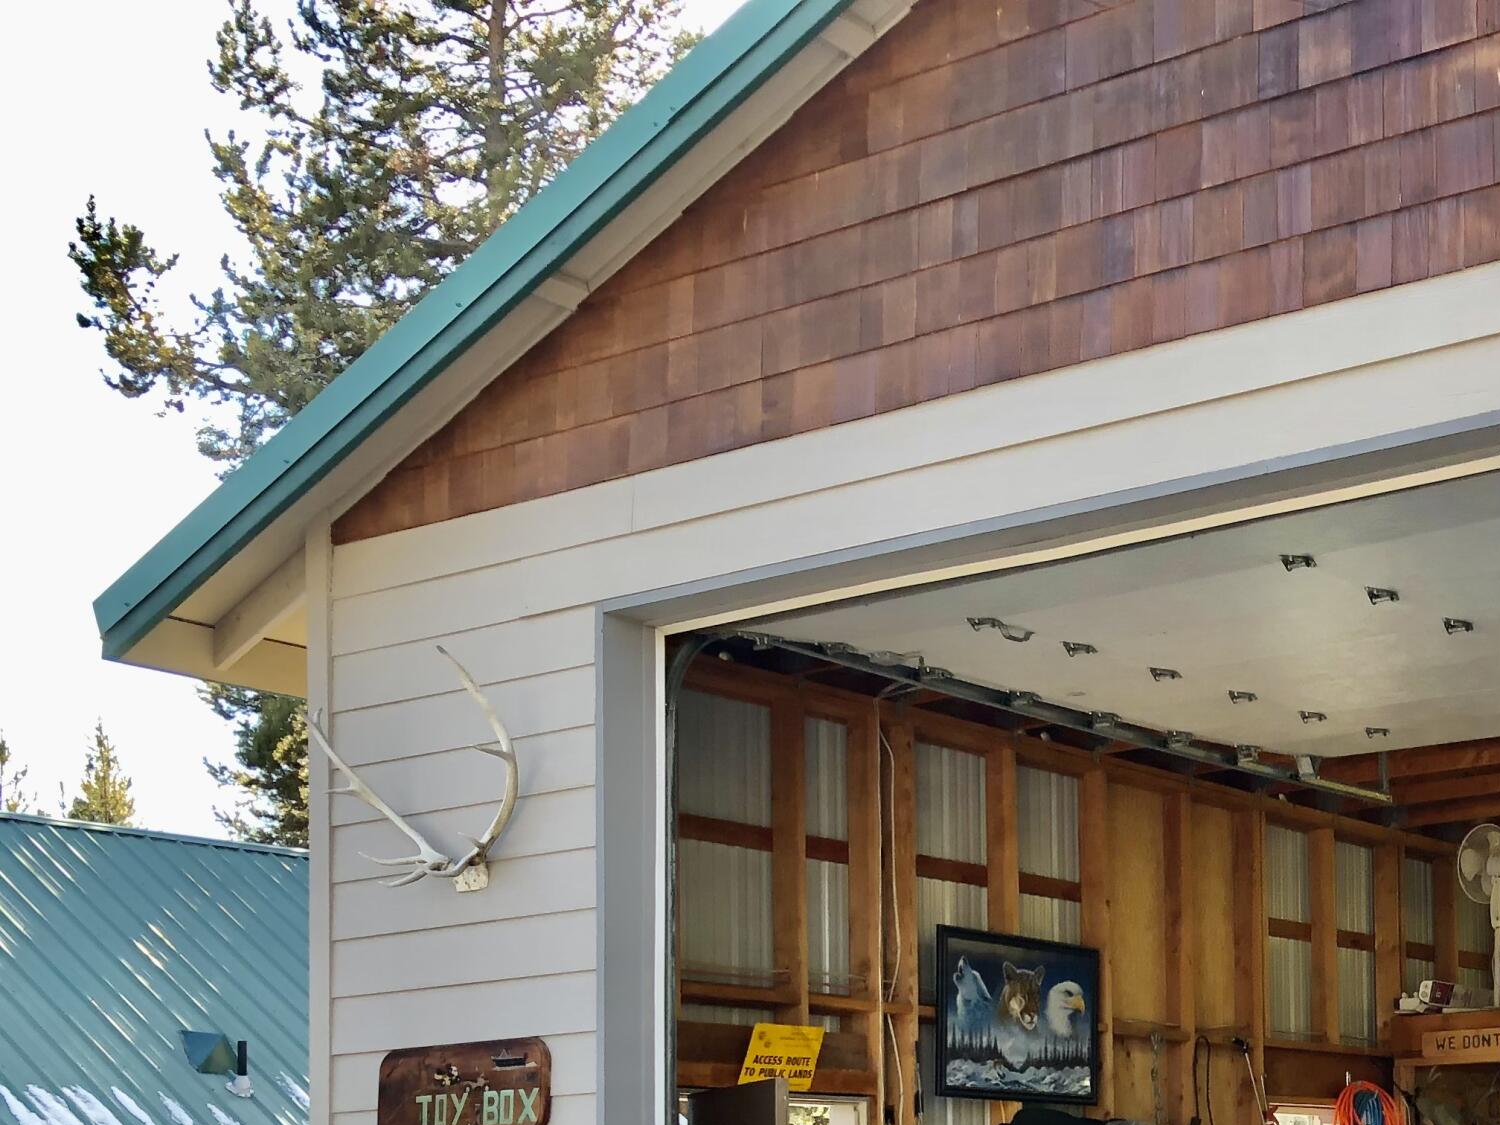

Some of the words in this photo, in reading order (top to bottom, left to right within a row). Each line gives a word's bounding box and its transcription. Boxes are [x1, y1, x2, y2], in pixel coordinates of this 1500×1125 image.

[1435, 1036, 1456, 1050] WE
[1463, 1034, 1500, 1049] DONT
[753, 1055, 783, 1065] ACCESS
[786, 1057, 811, 1066] ROUTE
[744, 1067, 756, 1076] TO
[758, 1068, 786, 1078] PUBLIC
[788, 1069, 813, 1078] LANDS
[482, 1087, 540, 1125] BOX
